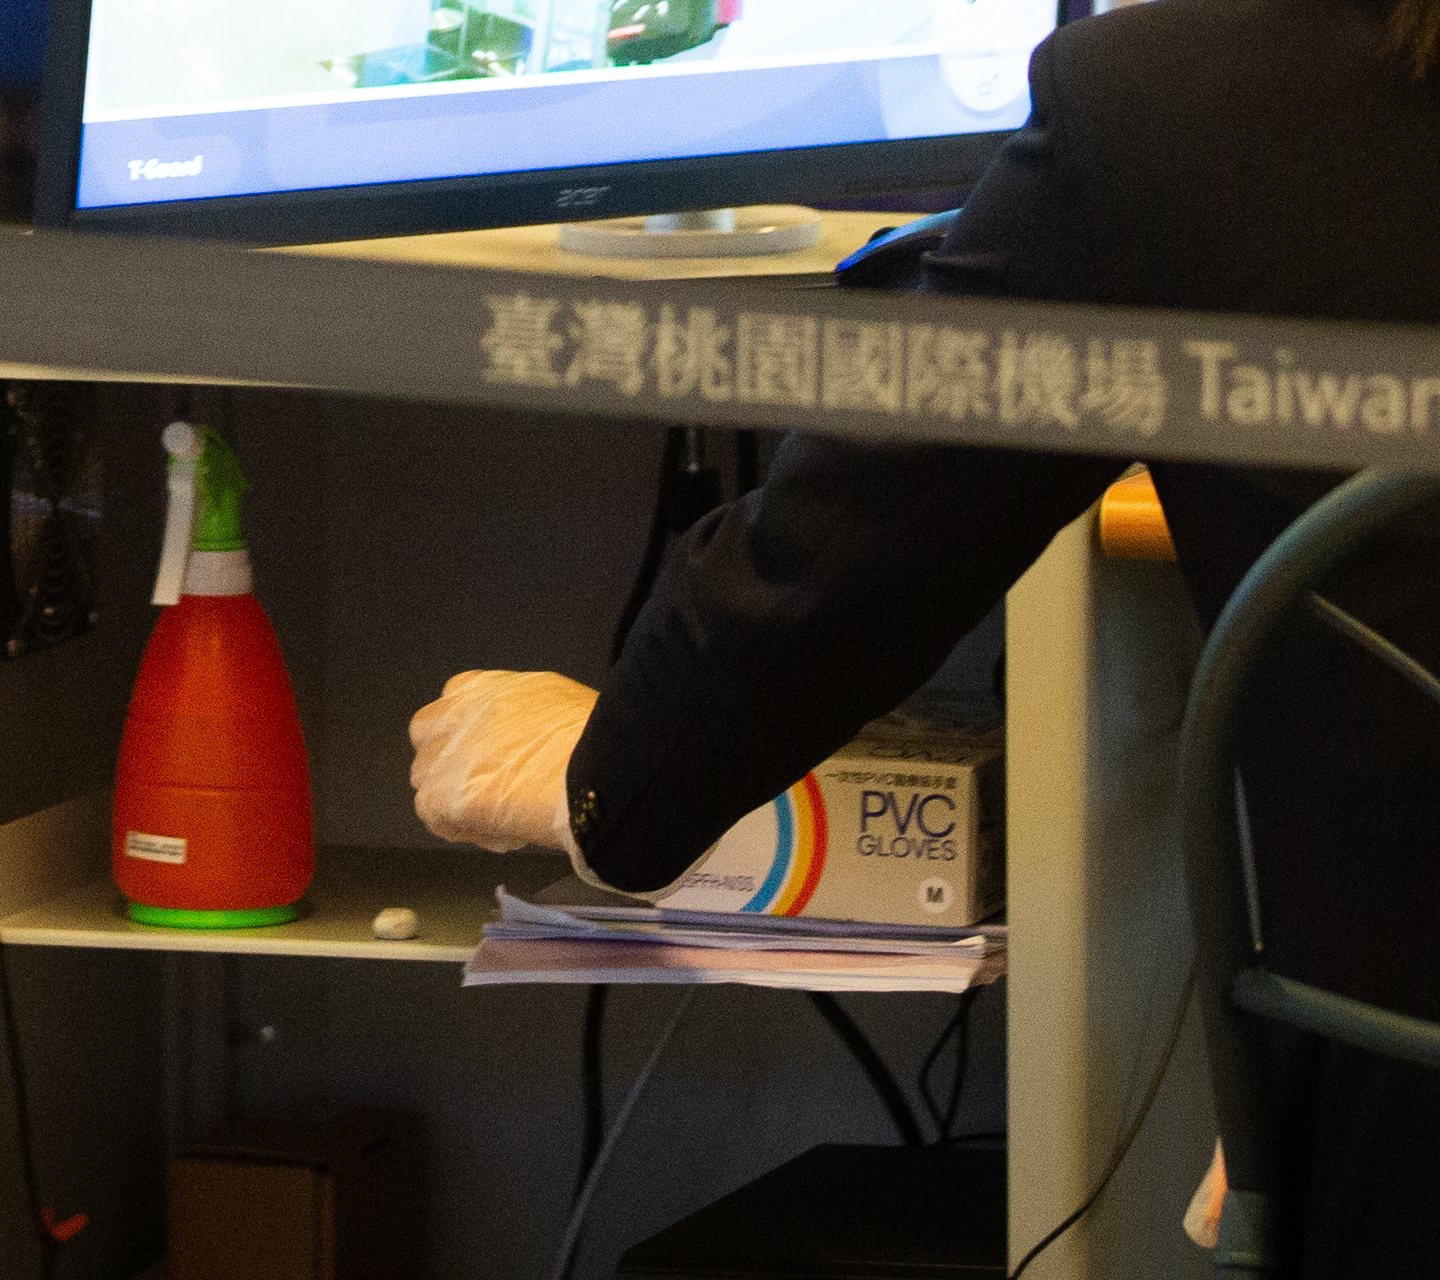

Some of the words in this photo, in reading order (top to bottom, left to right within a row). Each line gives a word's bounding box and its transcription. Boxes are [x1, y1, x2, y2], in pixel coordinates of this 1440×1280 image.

[480, 292, 1166, 438] 臺灣桃園國際機場
[859, 790, 958, 839] PVC
[856, 834, 958, 862] GLOVES
[926, 886, 944, 904] M
